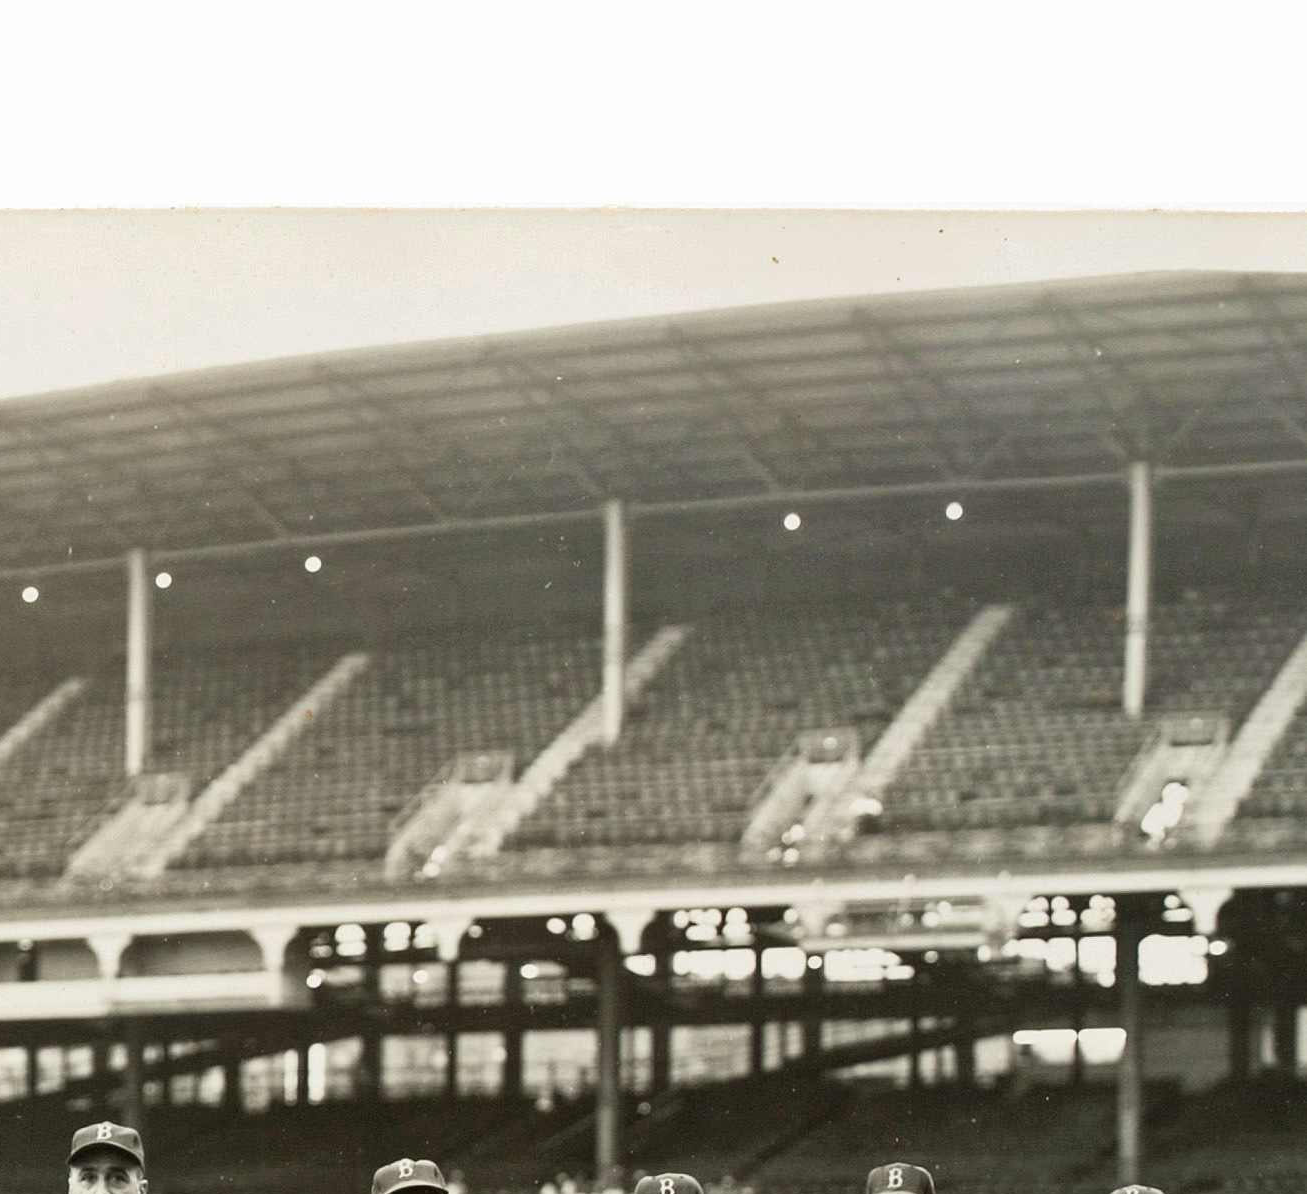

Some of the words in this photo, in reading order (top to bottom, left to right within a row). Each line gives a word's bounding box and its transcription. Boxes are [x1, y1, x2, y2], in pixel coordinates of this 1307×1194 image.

[95, 1122, 112, 1140] B
[396, 1159, 413, 1179] B
[885, 1167, 904, 1188] B
